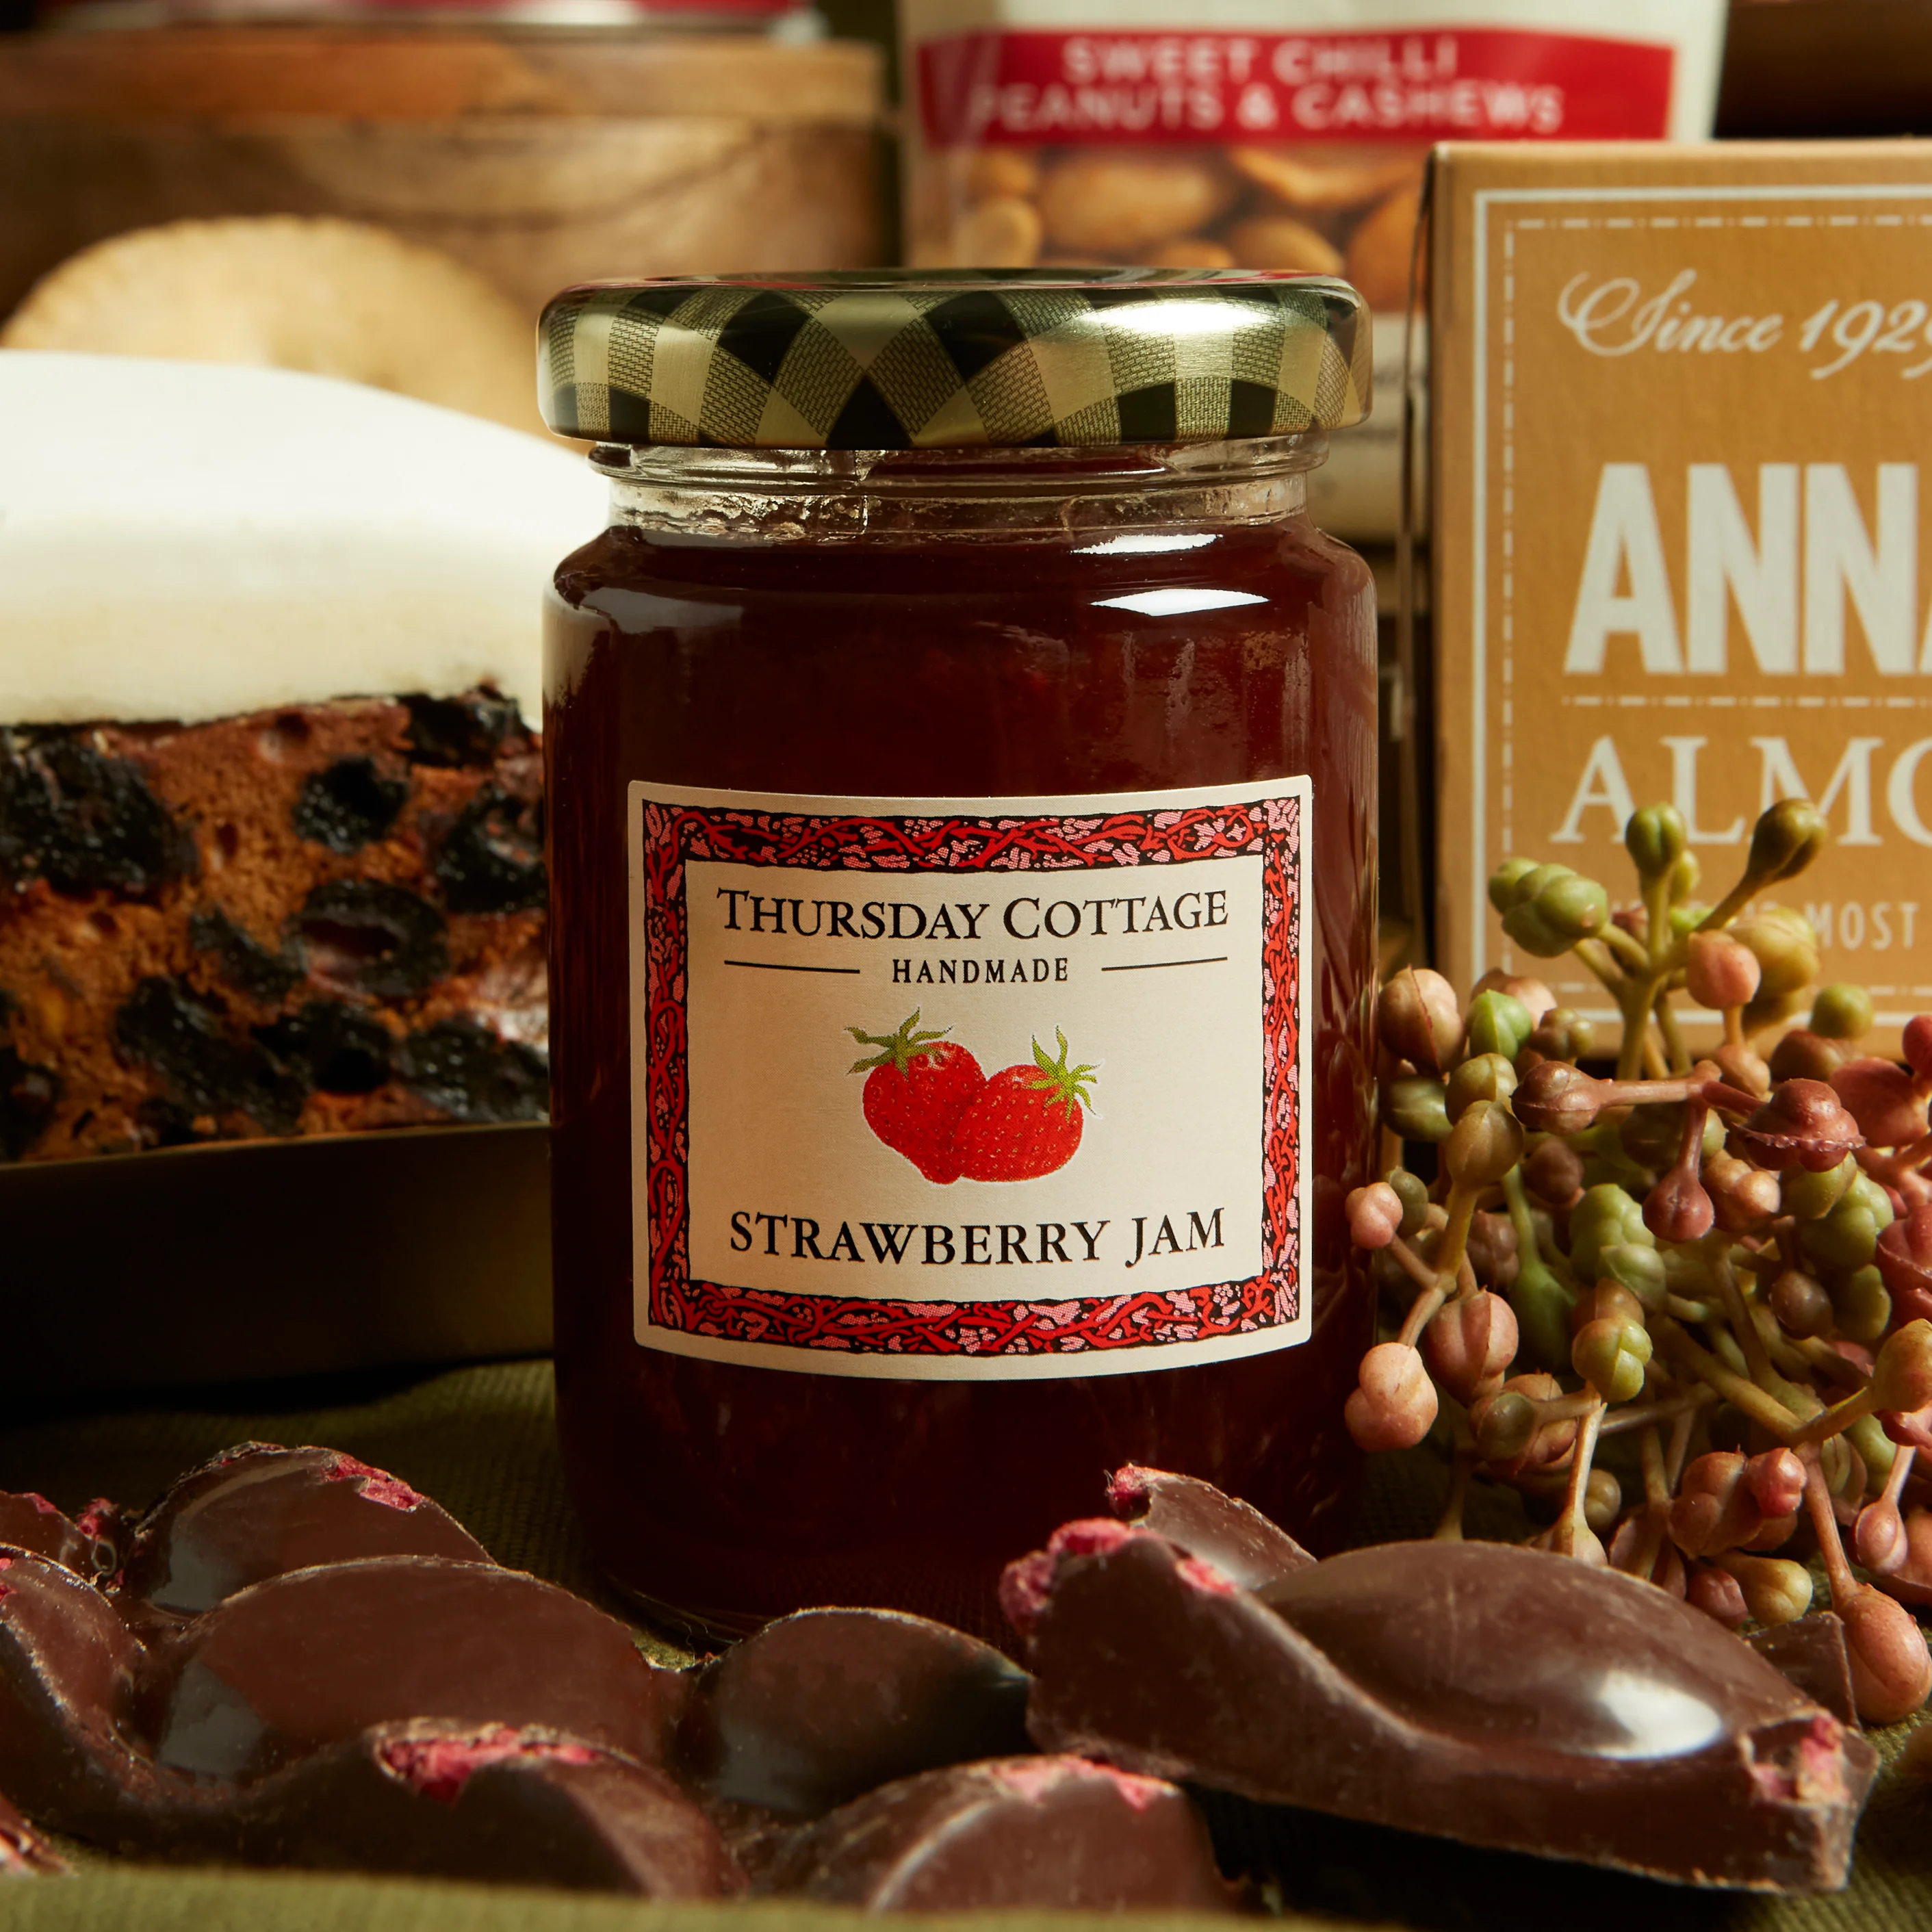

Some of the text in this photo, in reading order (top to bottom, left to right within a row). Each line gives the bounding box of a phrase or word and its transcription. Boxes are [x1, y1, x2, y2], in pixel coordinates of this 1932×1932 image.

[1062, 34, 1459, 86] SWEET CHILLI
[969, 79, 1564, 134] PEANUTS & CASHEWS
[1557, 268, 1783, 357] Since
[1562, 461, 1932, 676] ANN
[717, 886, 1229, 940] THURSDAY COTTAGE
[1804, 899, 1920, 951] MOST
[892, 957, 1069, 984] HANDMADE
[729, 1207, 1226, 1267] STRAWBERRY JAM
